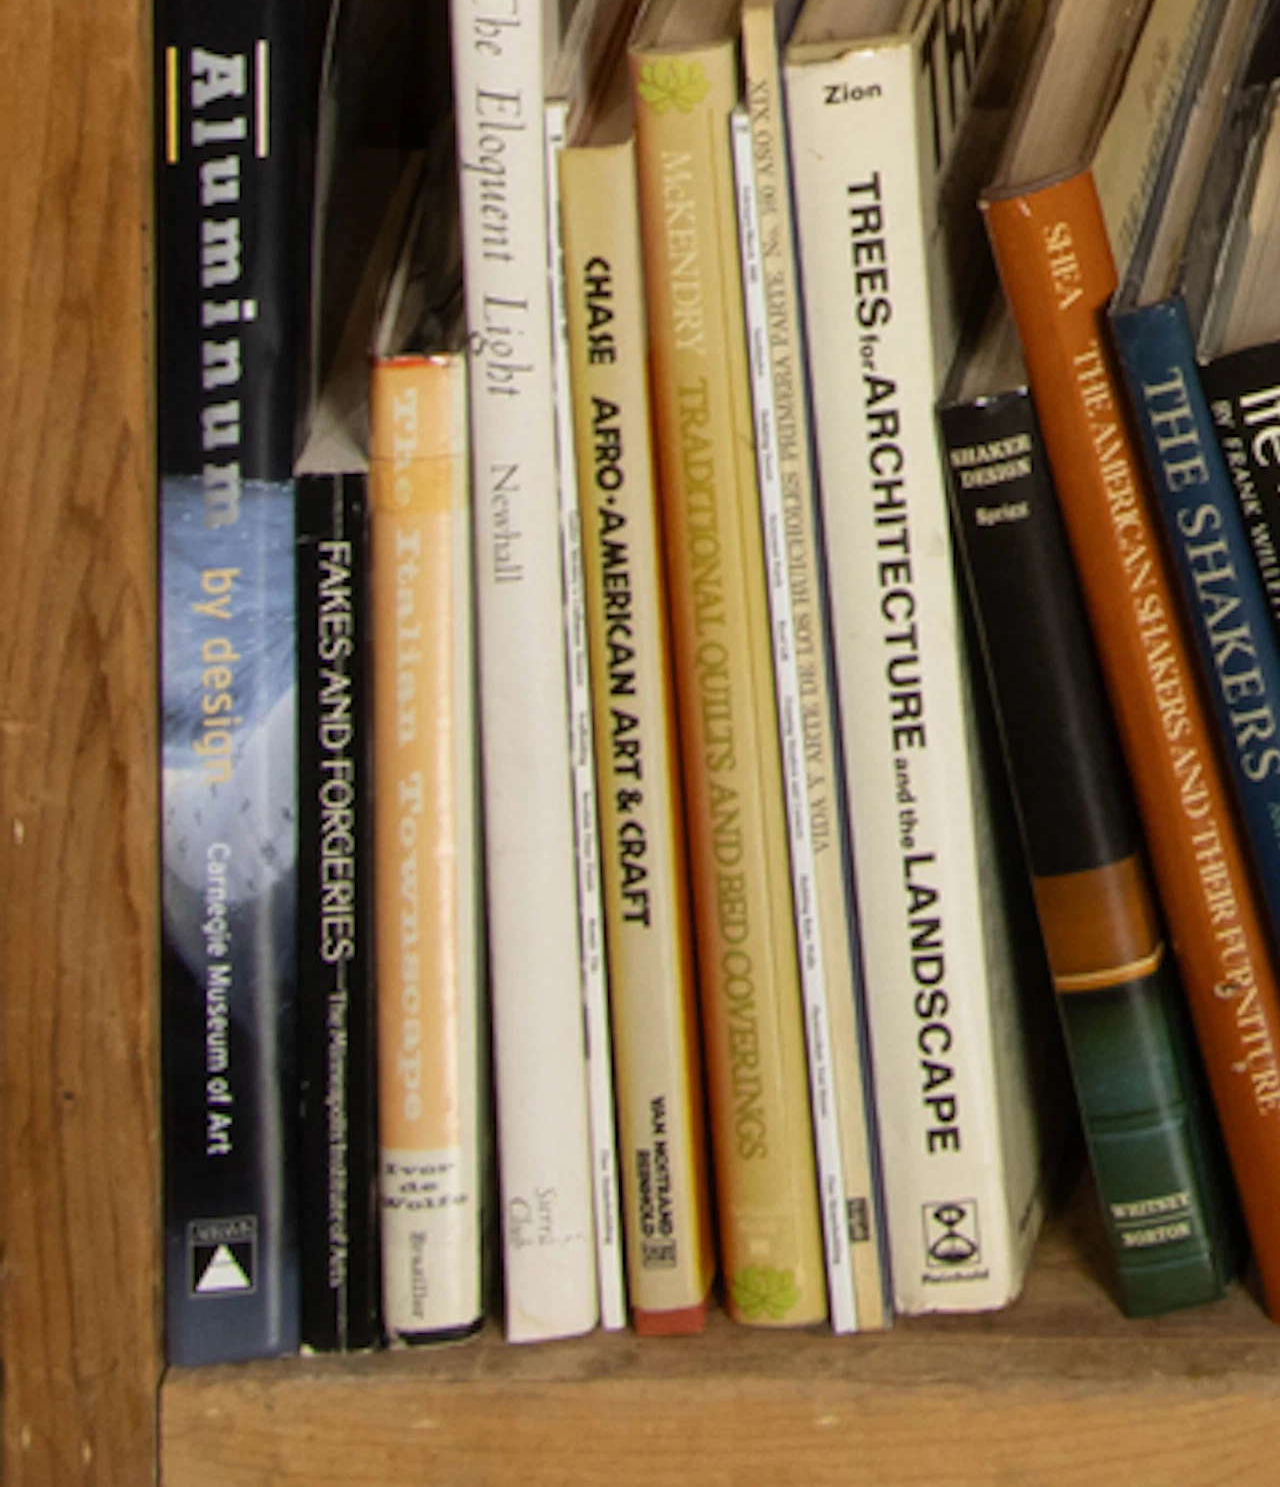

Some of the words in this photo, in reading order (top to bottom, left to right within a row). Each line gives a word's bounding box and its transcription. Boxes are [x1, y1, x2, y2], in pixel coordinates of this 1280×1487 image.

[822, 81, 883, 105] Zion
[456, 85, 529, 265] Eloquent
[190, 46, 256, 527] Aluminum
[844, 170, 891, 328] TREES
[1039, 218, 1088, 311] SHEA
[462, 290, 534, 400] Light
[581, 256, 617, 364] CHASE
[857, 334, 880, 370] for
[1138, 366, 1211, 493] THE
[488, 462, 522, 583] Newhall
[861, 372, 928, 751] ARCHITECTURE
[193, 567, 238, 623] by
[317, 541, 351, 658] FAKES
[193, 636, 238, 784] design
[319, 669, 353, 749] AND
[610, 706, 642, 780] ART
[615, 787, 645, 813] &
[893, 756, 916, 802] and
[898, 808, 920, 849] the
[200, 841, 231, 951] Carnegie
[318, 760, 356, 961] FORGERIES
[616, 818, 653, 928] CRAFT
[205, 963, 232, 1071] Museum
[902, 851, 962, 1153] LANDSCAPE
[206, 1079, 232, 1104] of
[206, 1113, 232, 1155] Art
